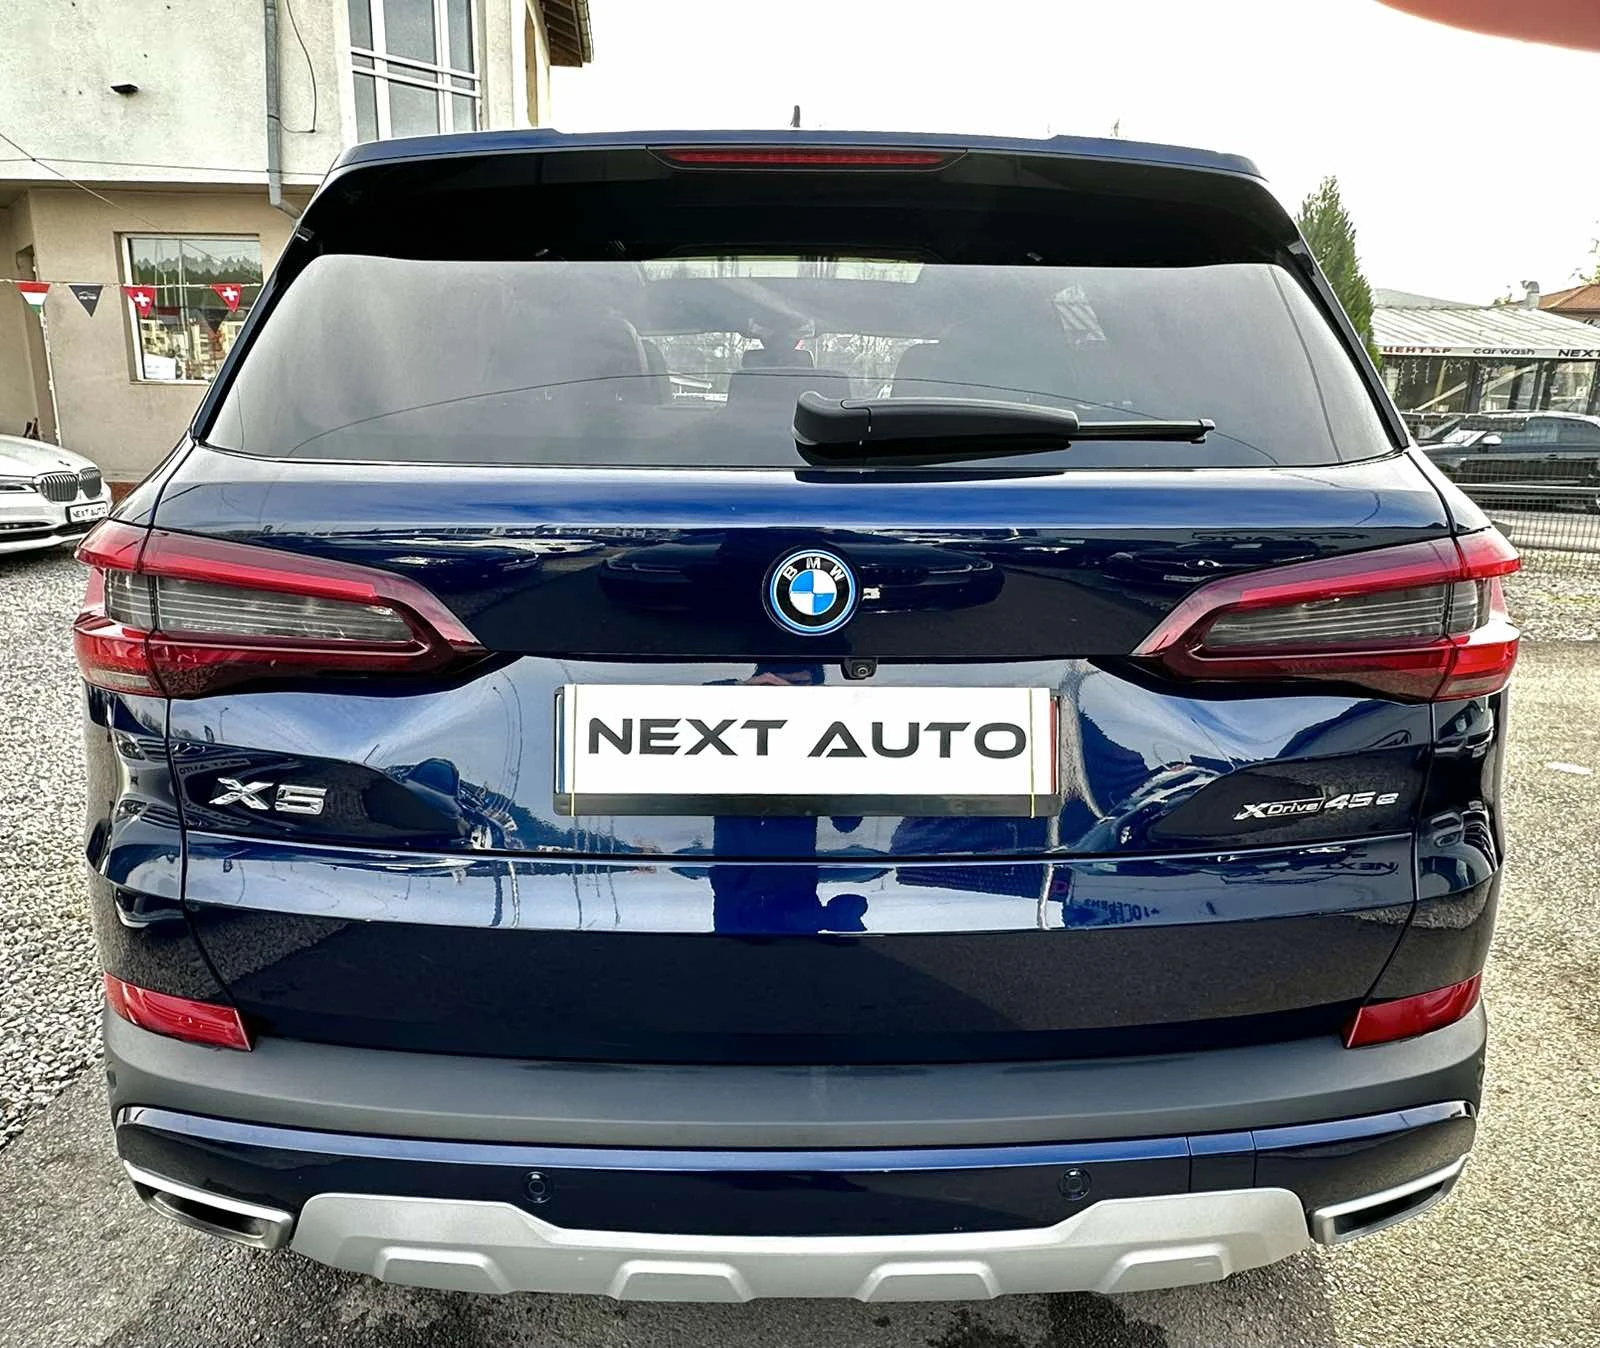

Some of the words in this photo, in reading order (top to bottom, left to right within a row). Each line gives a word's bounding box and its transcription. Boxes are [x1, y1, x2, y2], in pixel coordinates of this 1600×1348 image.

[782, 557, 845, 581] BMW
[588, 717, 788, 756] NEXT
[807, 720, 1027, 760] AUTO
[208, 777, 328, 815] X5
